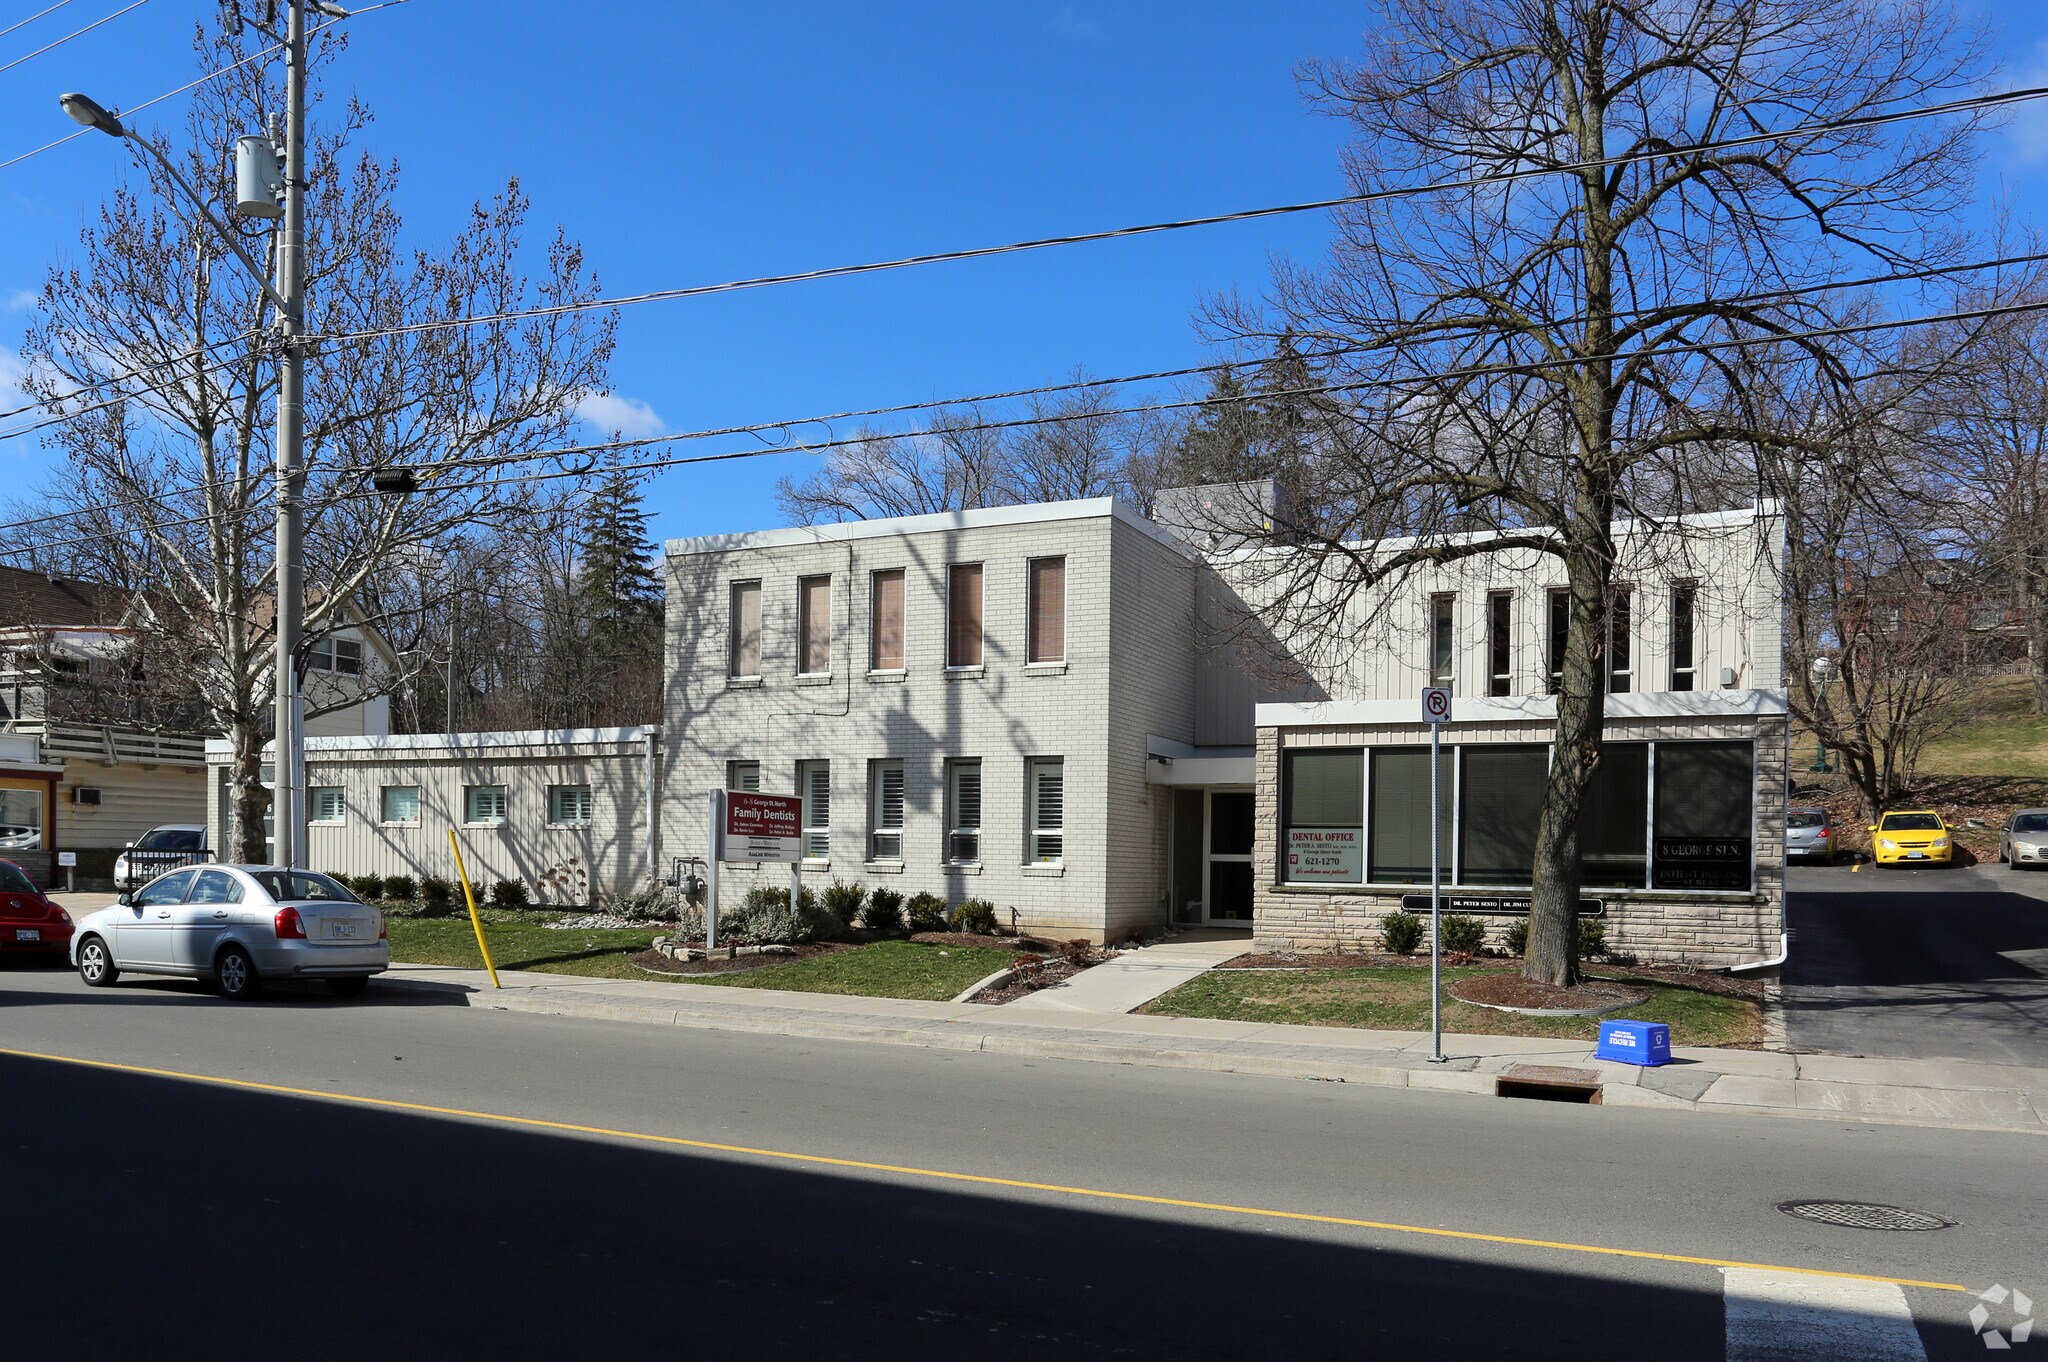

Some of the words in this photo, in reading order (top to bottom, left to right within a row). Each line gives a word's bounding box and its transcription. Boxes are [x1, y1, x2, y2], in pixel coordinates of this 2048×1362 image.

[267, 803, 272, 813] 6
[754, 799, 768, 807] George
[734, 806, 761, 821] Family
[763, 809, 795, 821] Dentists
[1292, 832, 1323, 841] DENTAL
[1325, 832, 1354, 841] OFFICE
[1663, 845, 1668, 855] 8
[1671, 845, 1713, 856] GEORGE
